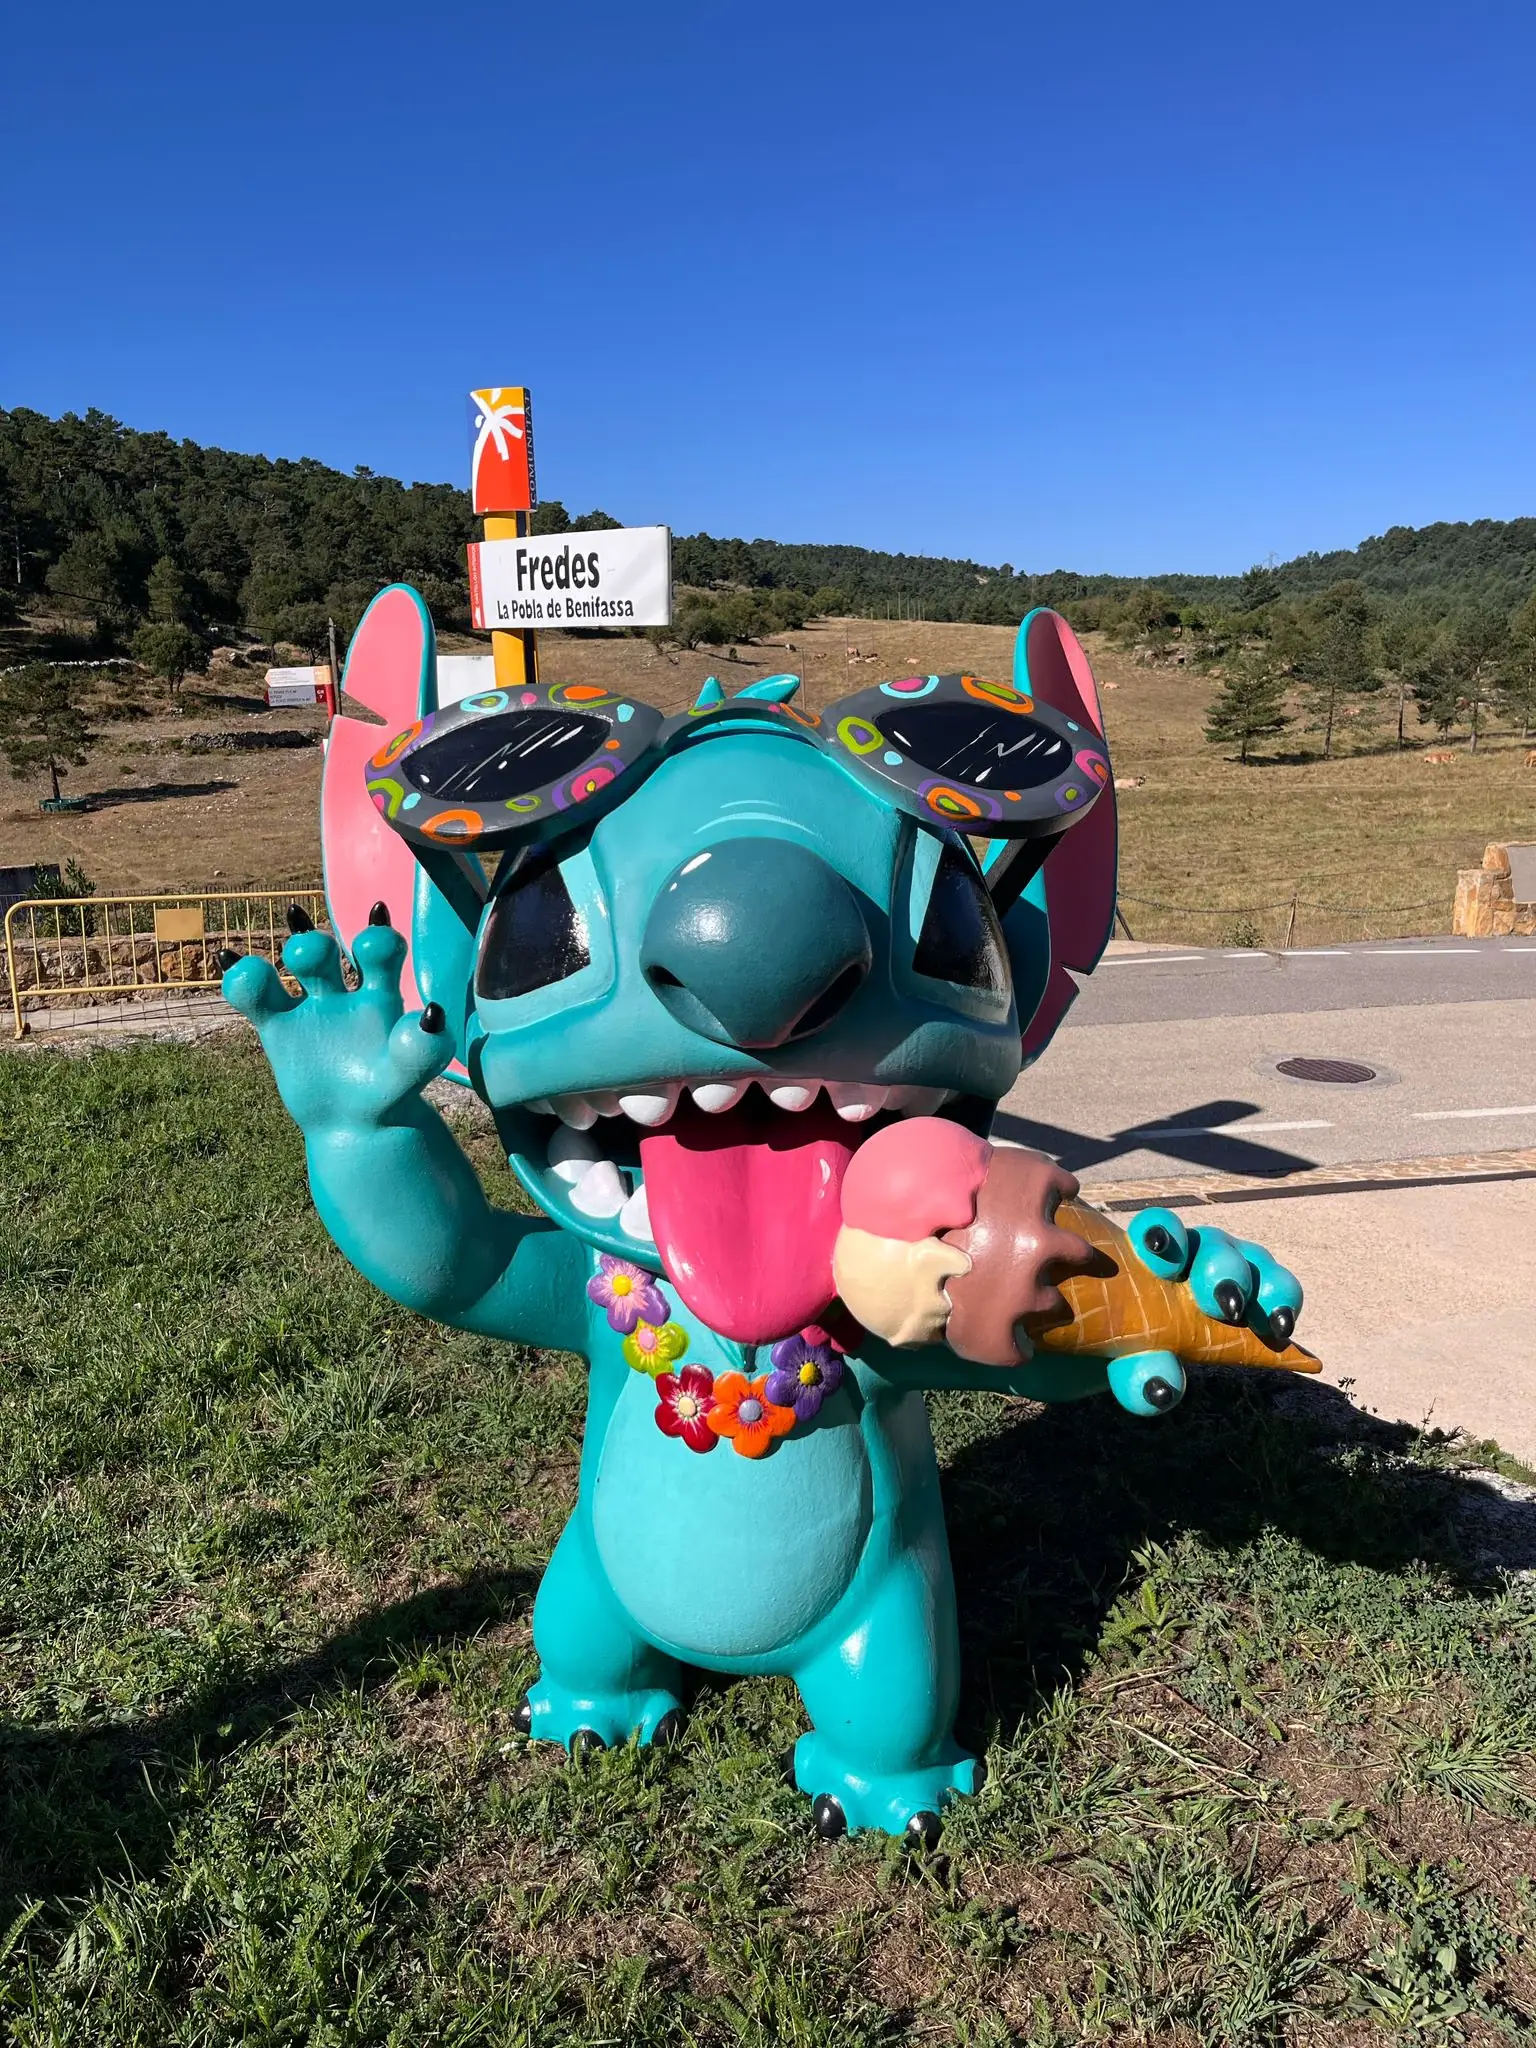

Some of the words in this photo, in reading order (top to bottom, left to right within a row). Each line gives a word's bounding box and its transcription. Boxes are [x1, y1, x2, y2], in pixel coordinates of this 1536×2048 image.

[524, 396, 536, 504] COMUNITAT
[515, 545, 600, 591] Fredes
[497, 600, 510, 620] La
[511, 598, 544, 620] Pobla
[546, 599, 562, 618] de
[565, 595, 634, 618] Benifassa
